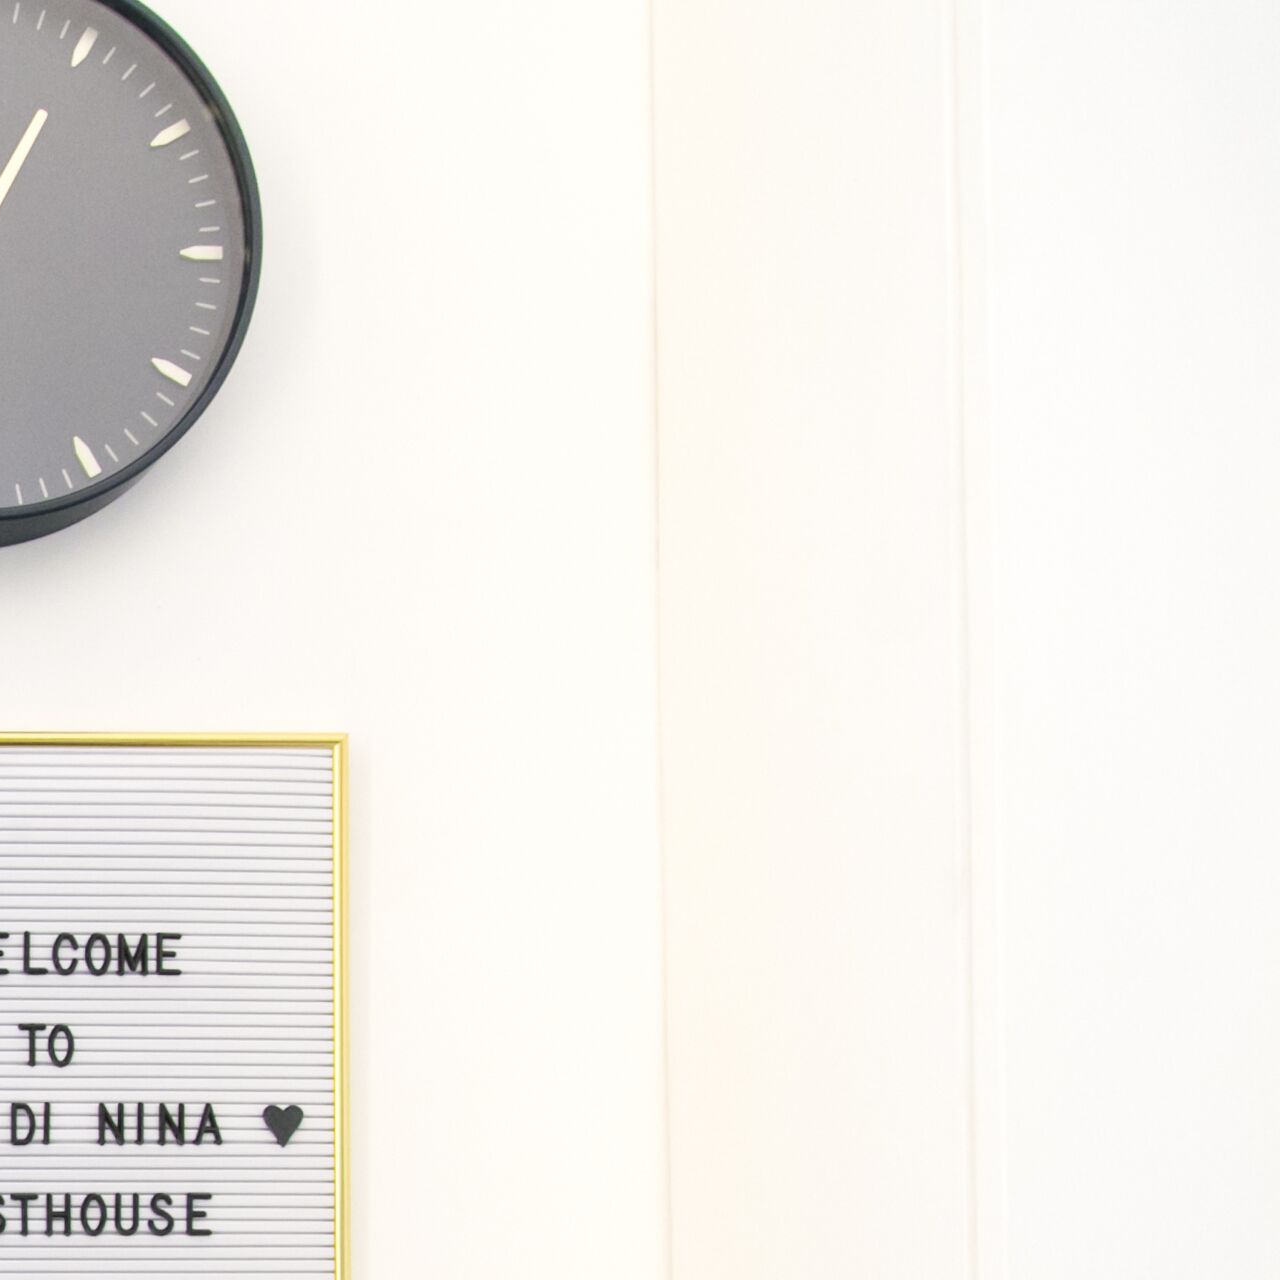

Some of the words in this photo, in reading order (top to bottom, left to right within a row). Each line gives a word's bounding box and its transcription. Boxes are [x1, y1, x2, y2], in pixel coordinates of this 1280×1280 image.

[18, 1023, 75, 1067] TO
[10, 1102, 51, 1146] DI
[97, 1102, 223, 1146] NINA
